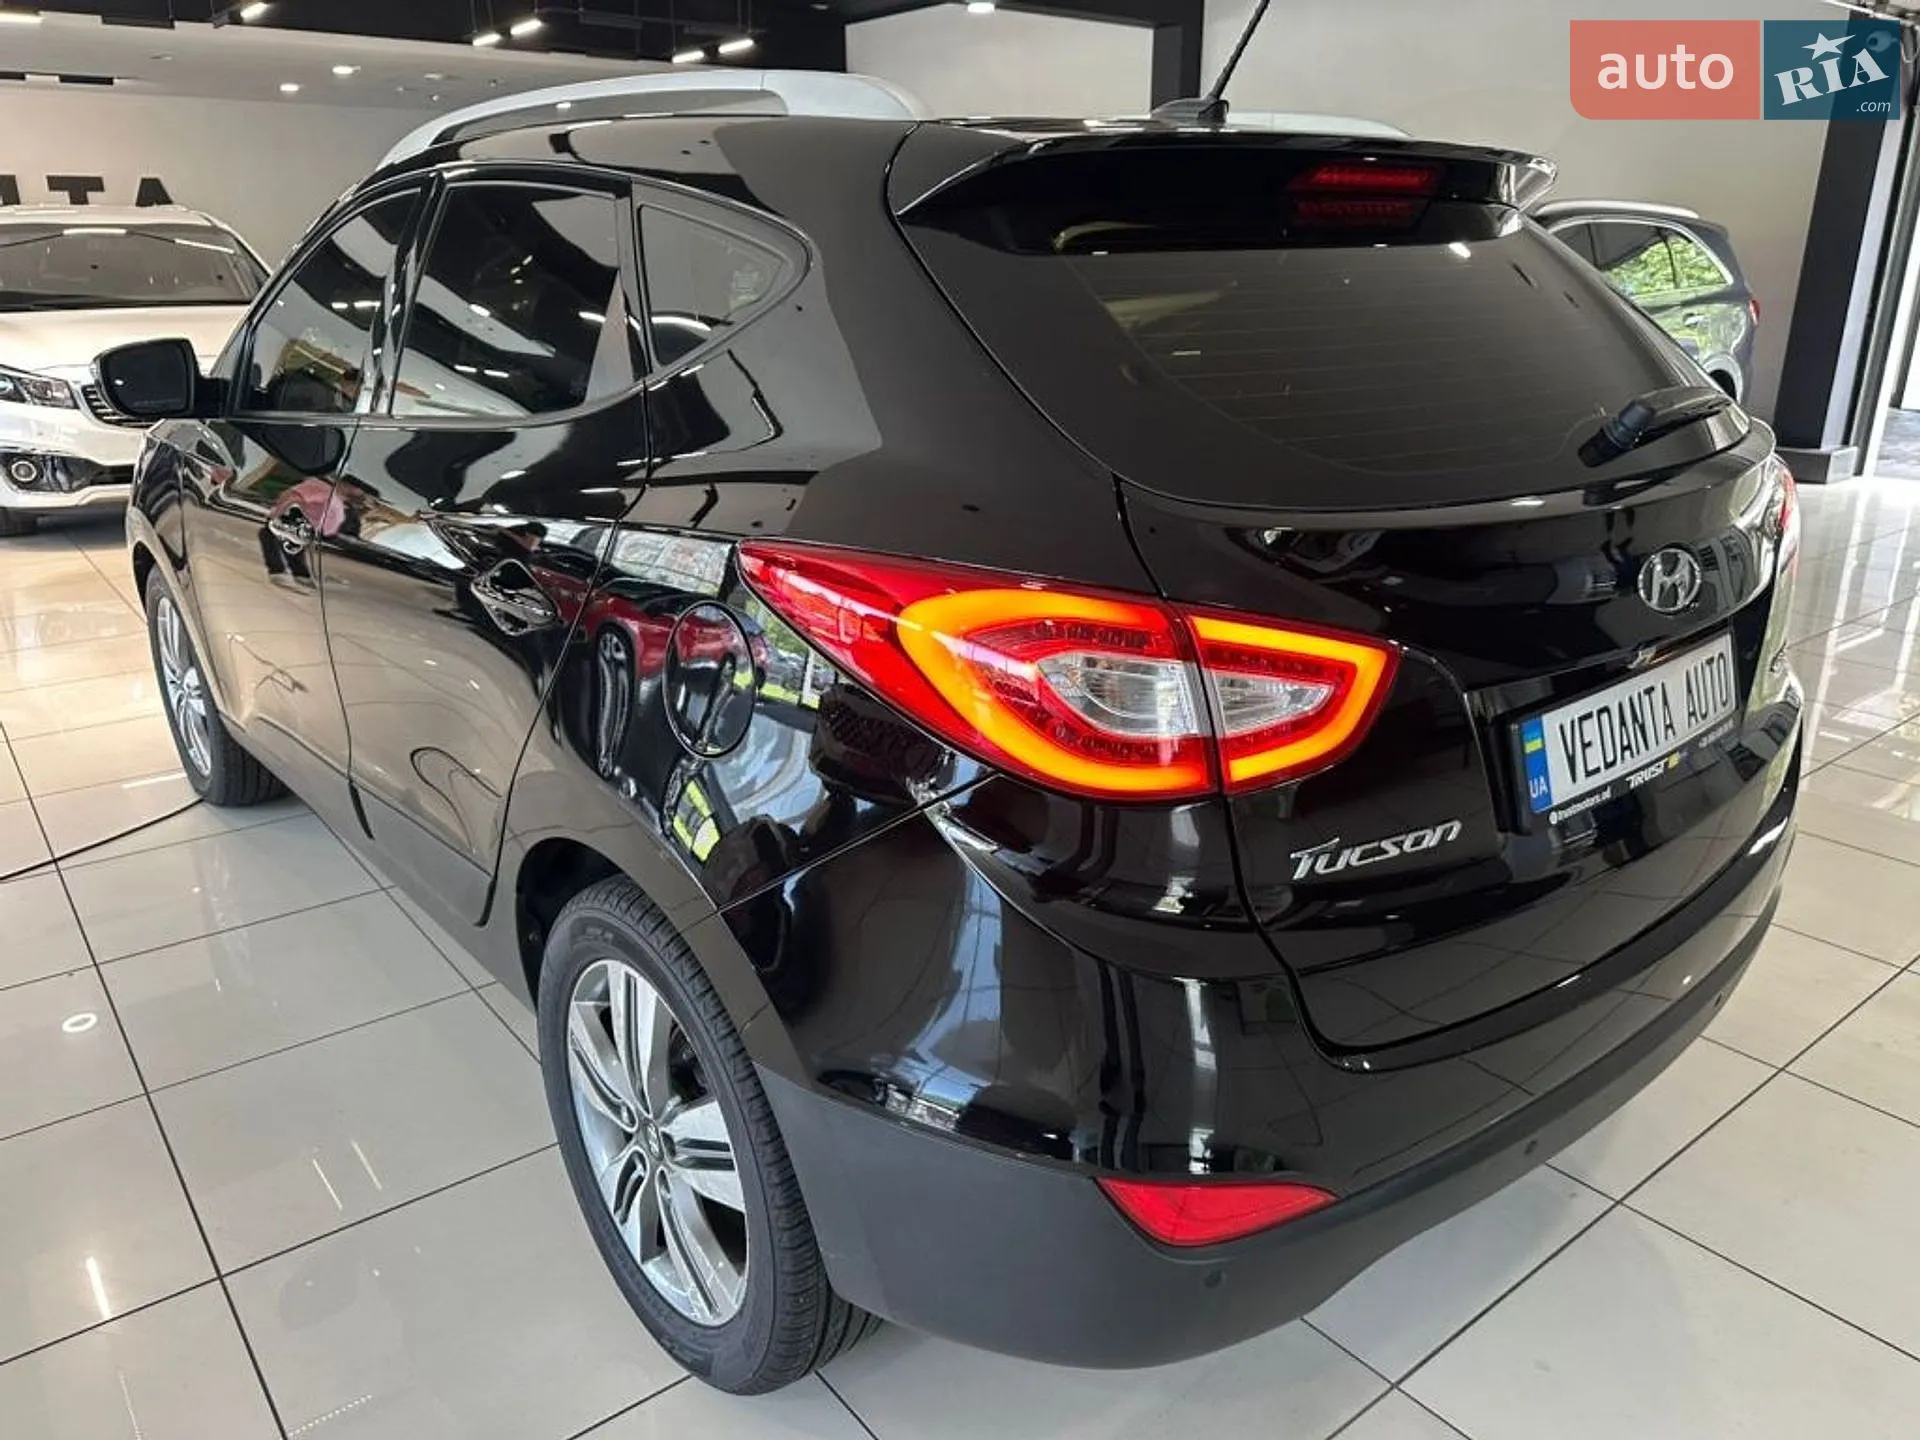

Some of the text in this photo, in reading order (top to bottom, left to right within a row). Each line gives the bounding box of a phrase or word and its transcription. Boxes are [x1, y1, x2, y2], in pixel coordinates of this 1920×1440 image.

[1528, 776, 1549, 798] UA
[1558, 680, 1677, 784] VEDANTA
[1685, 651, 1729, 728] AUTO
[1625, 758, 1669, 789] TRUST
[1289, 818, 1463, 881] Tucson
